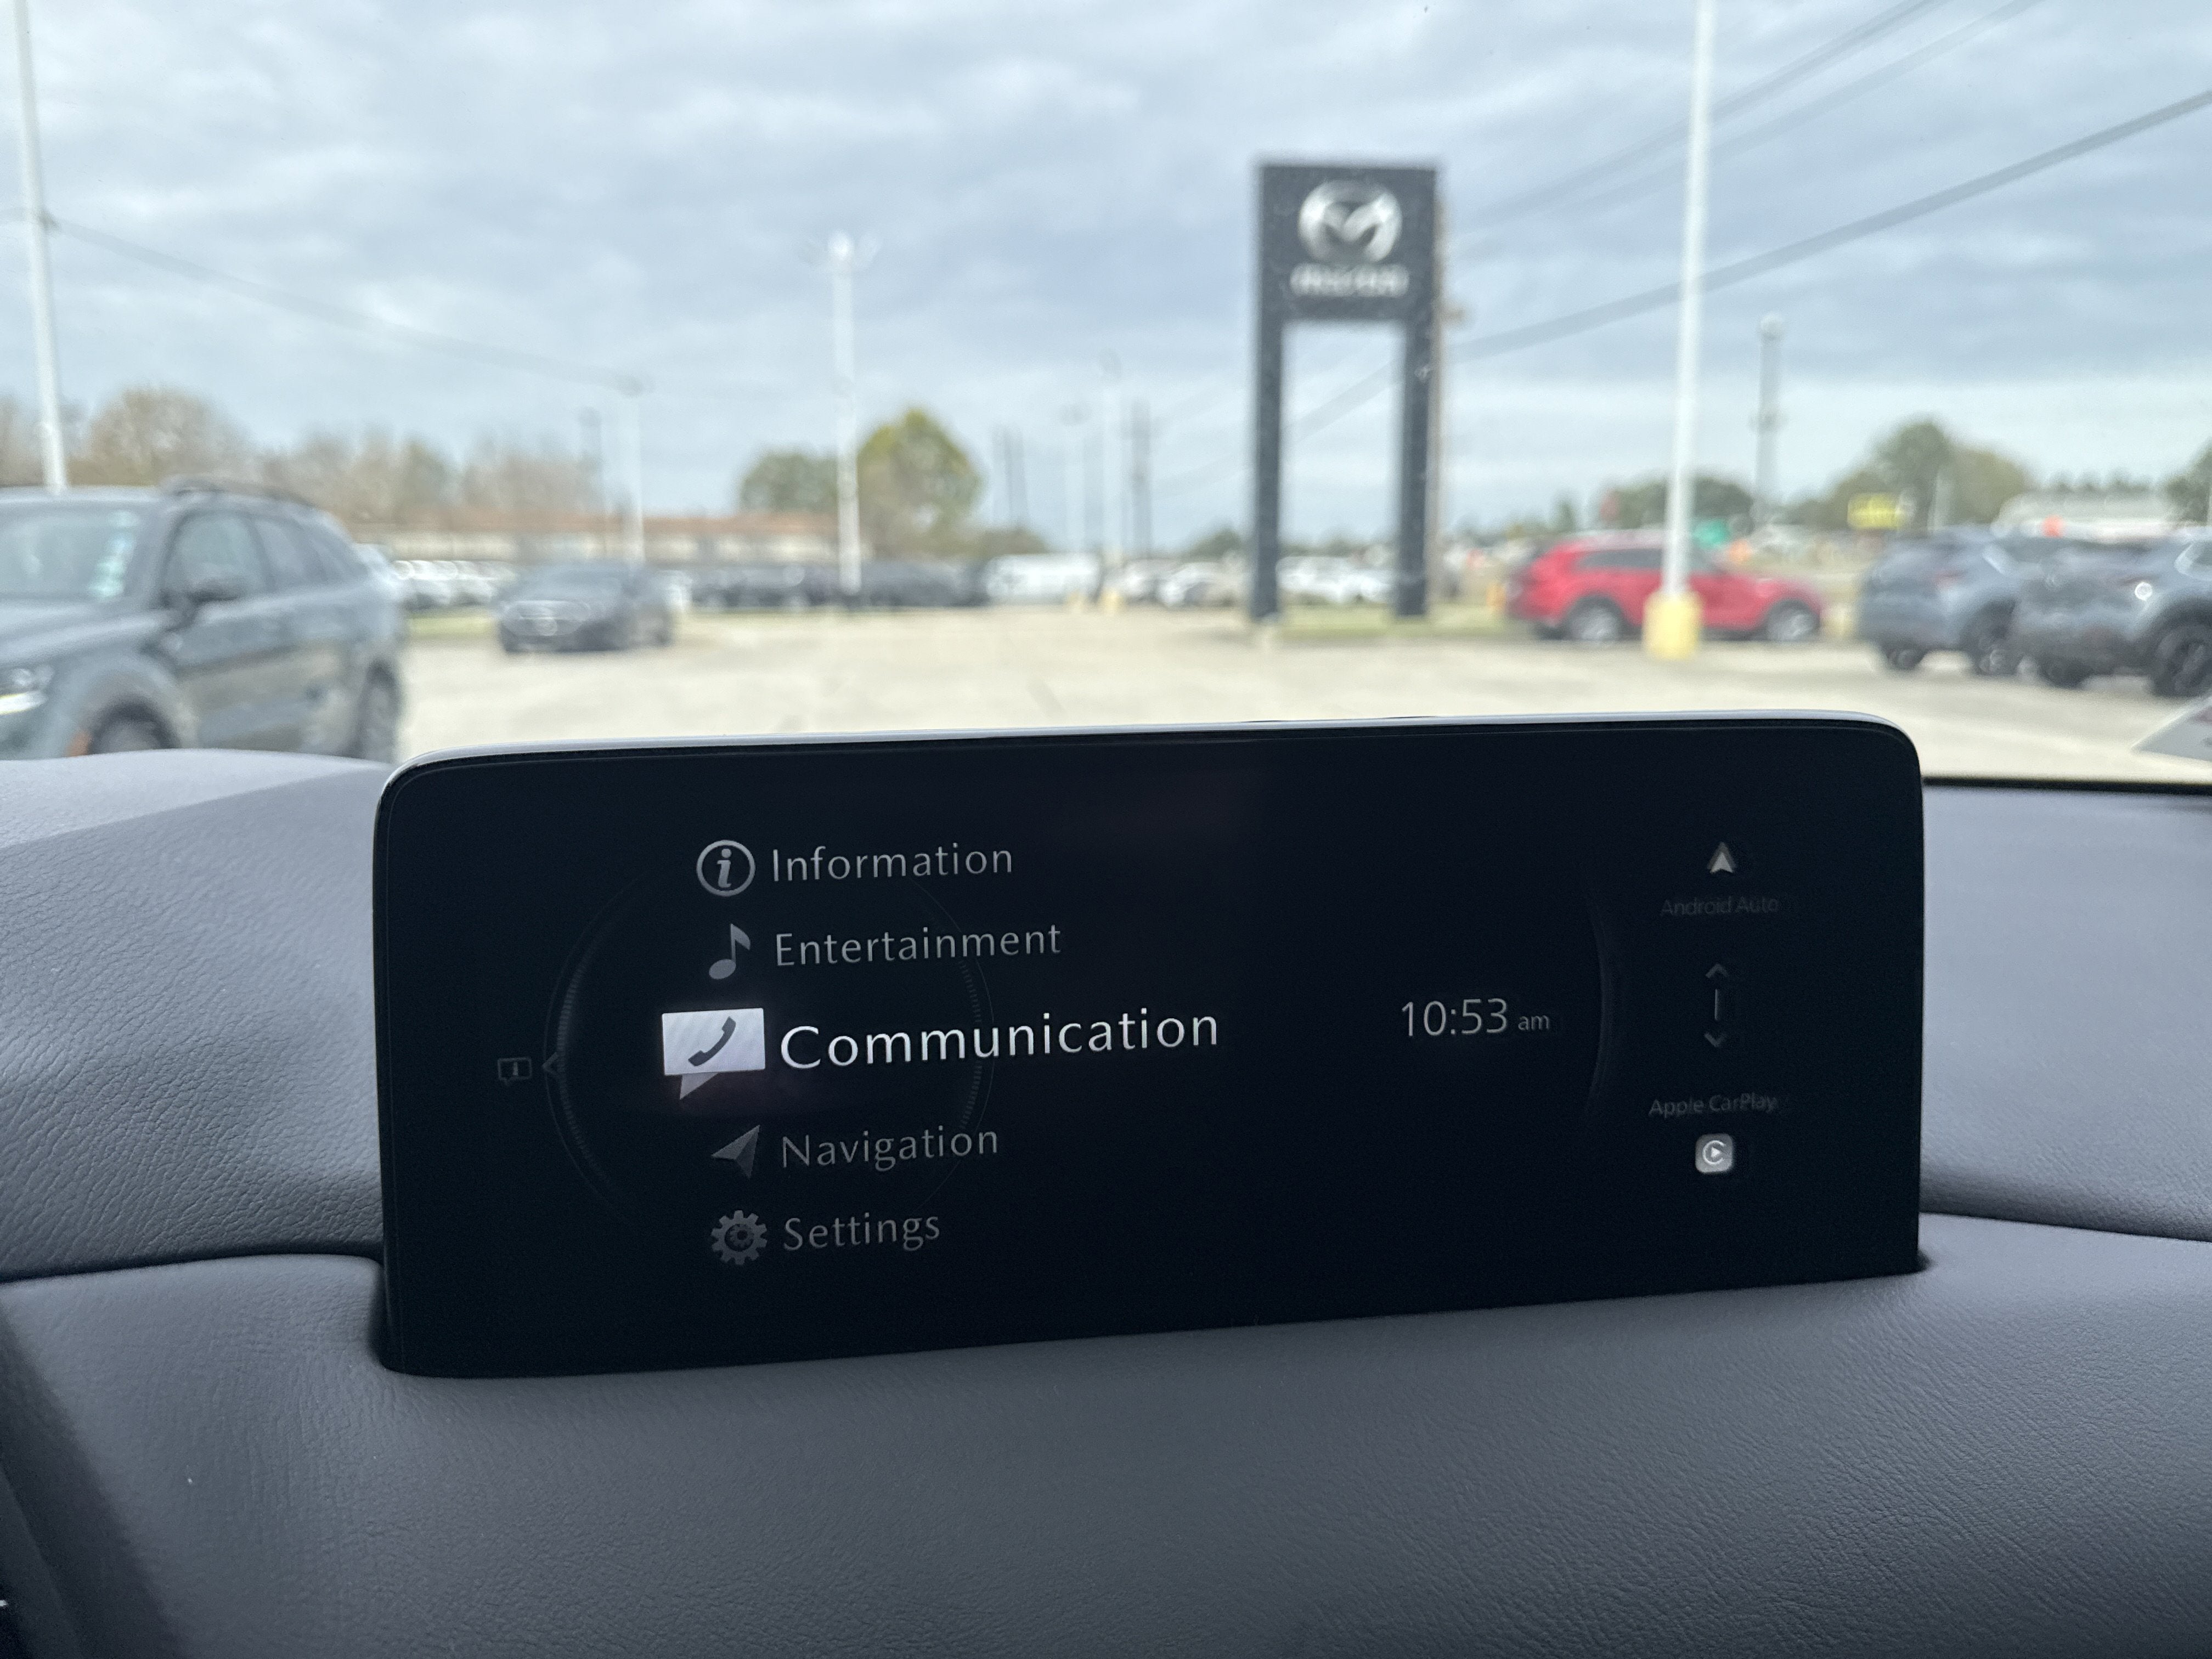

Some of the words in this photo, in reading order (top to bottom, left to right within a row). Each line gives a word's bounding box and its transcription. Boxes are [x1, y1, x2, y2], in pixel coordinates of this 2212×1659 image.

[771, 841, 1013, 883] Information
[1660, 896, 1733, 917] Android
[1734, 895, 1780, 915] Auto
[775, 924, 1062, 967] Entertainment
[1400, 997, 1509, 1037] 10:53
[1516, 1014, 1551, 1032] am
[780, 1006, 1218, 1070] Communication
[1648, 1098, 1705, 1119] Apple
[1708, 1092, 1779, 1114] CarPlay
[781, 1123, 999, 1172] Navigation
[783, 1211, 941, 1252] Settings
